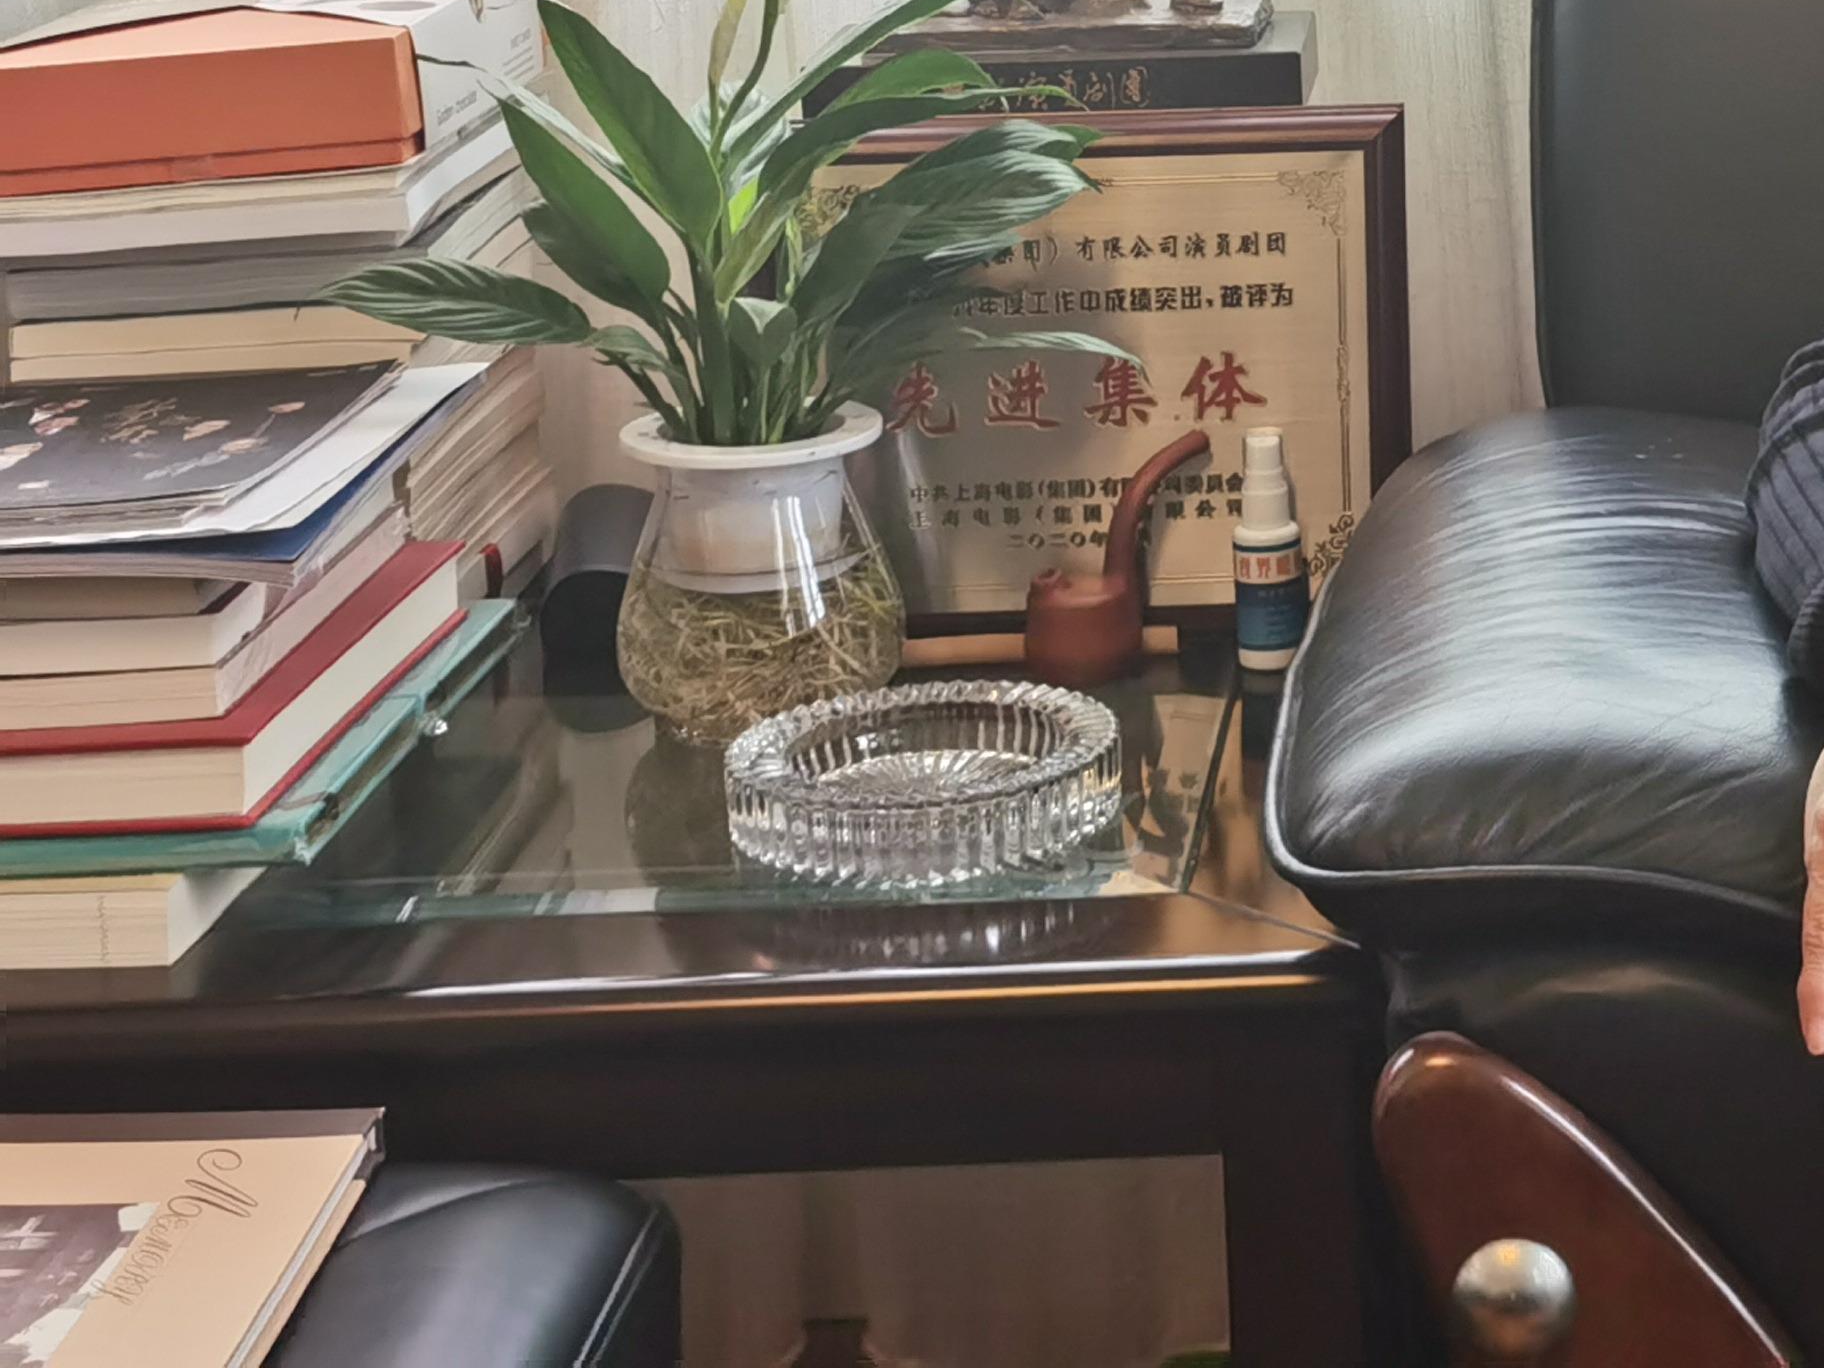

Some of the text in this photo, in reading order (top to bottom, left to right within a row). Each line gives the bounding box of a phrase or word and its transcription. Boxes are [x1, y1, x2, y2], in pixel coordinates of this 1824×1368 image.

[982, 232, 1288, 272] 团）有限公司演员剧团
[886, 350, 1268, 436] 先进集体
